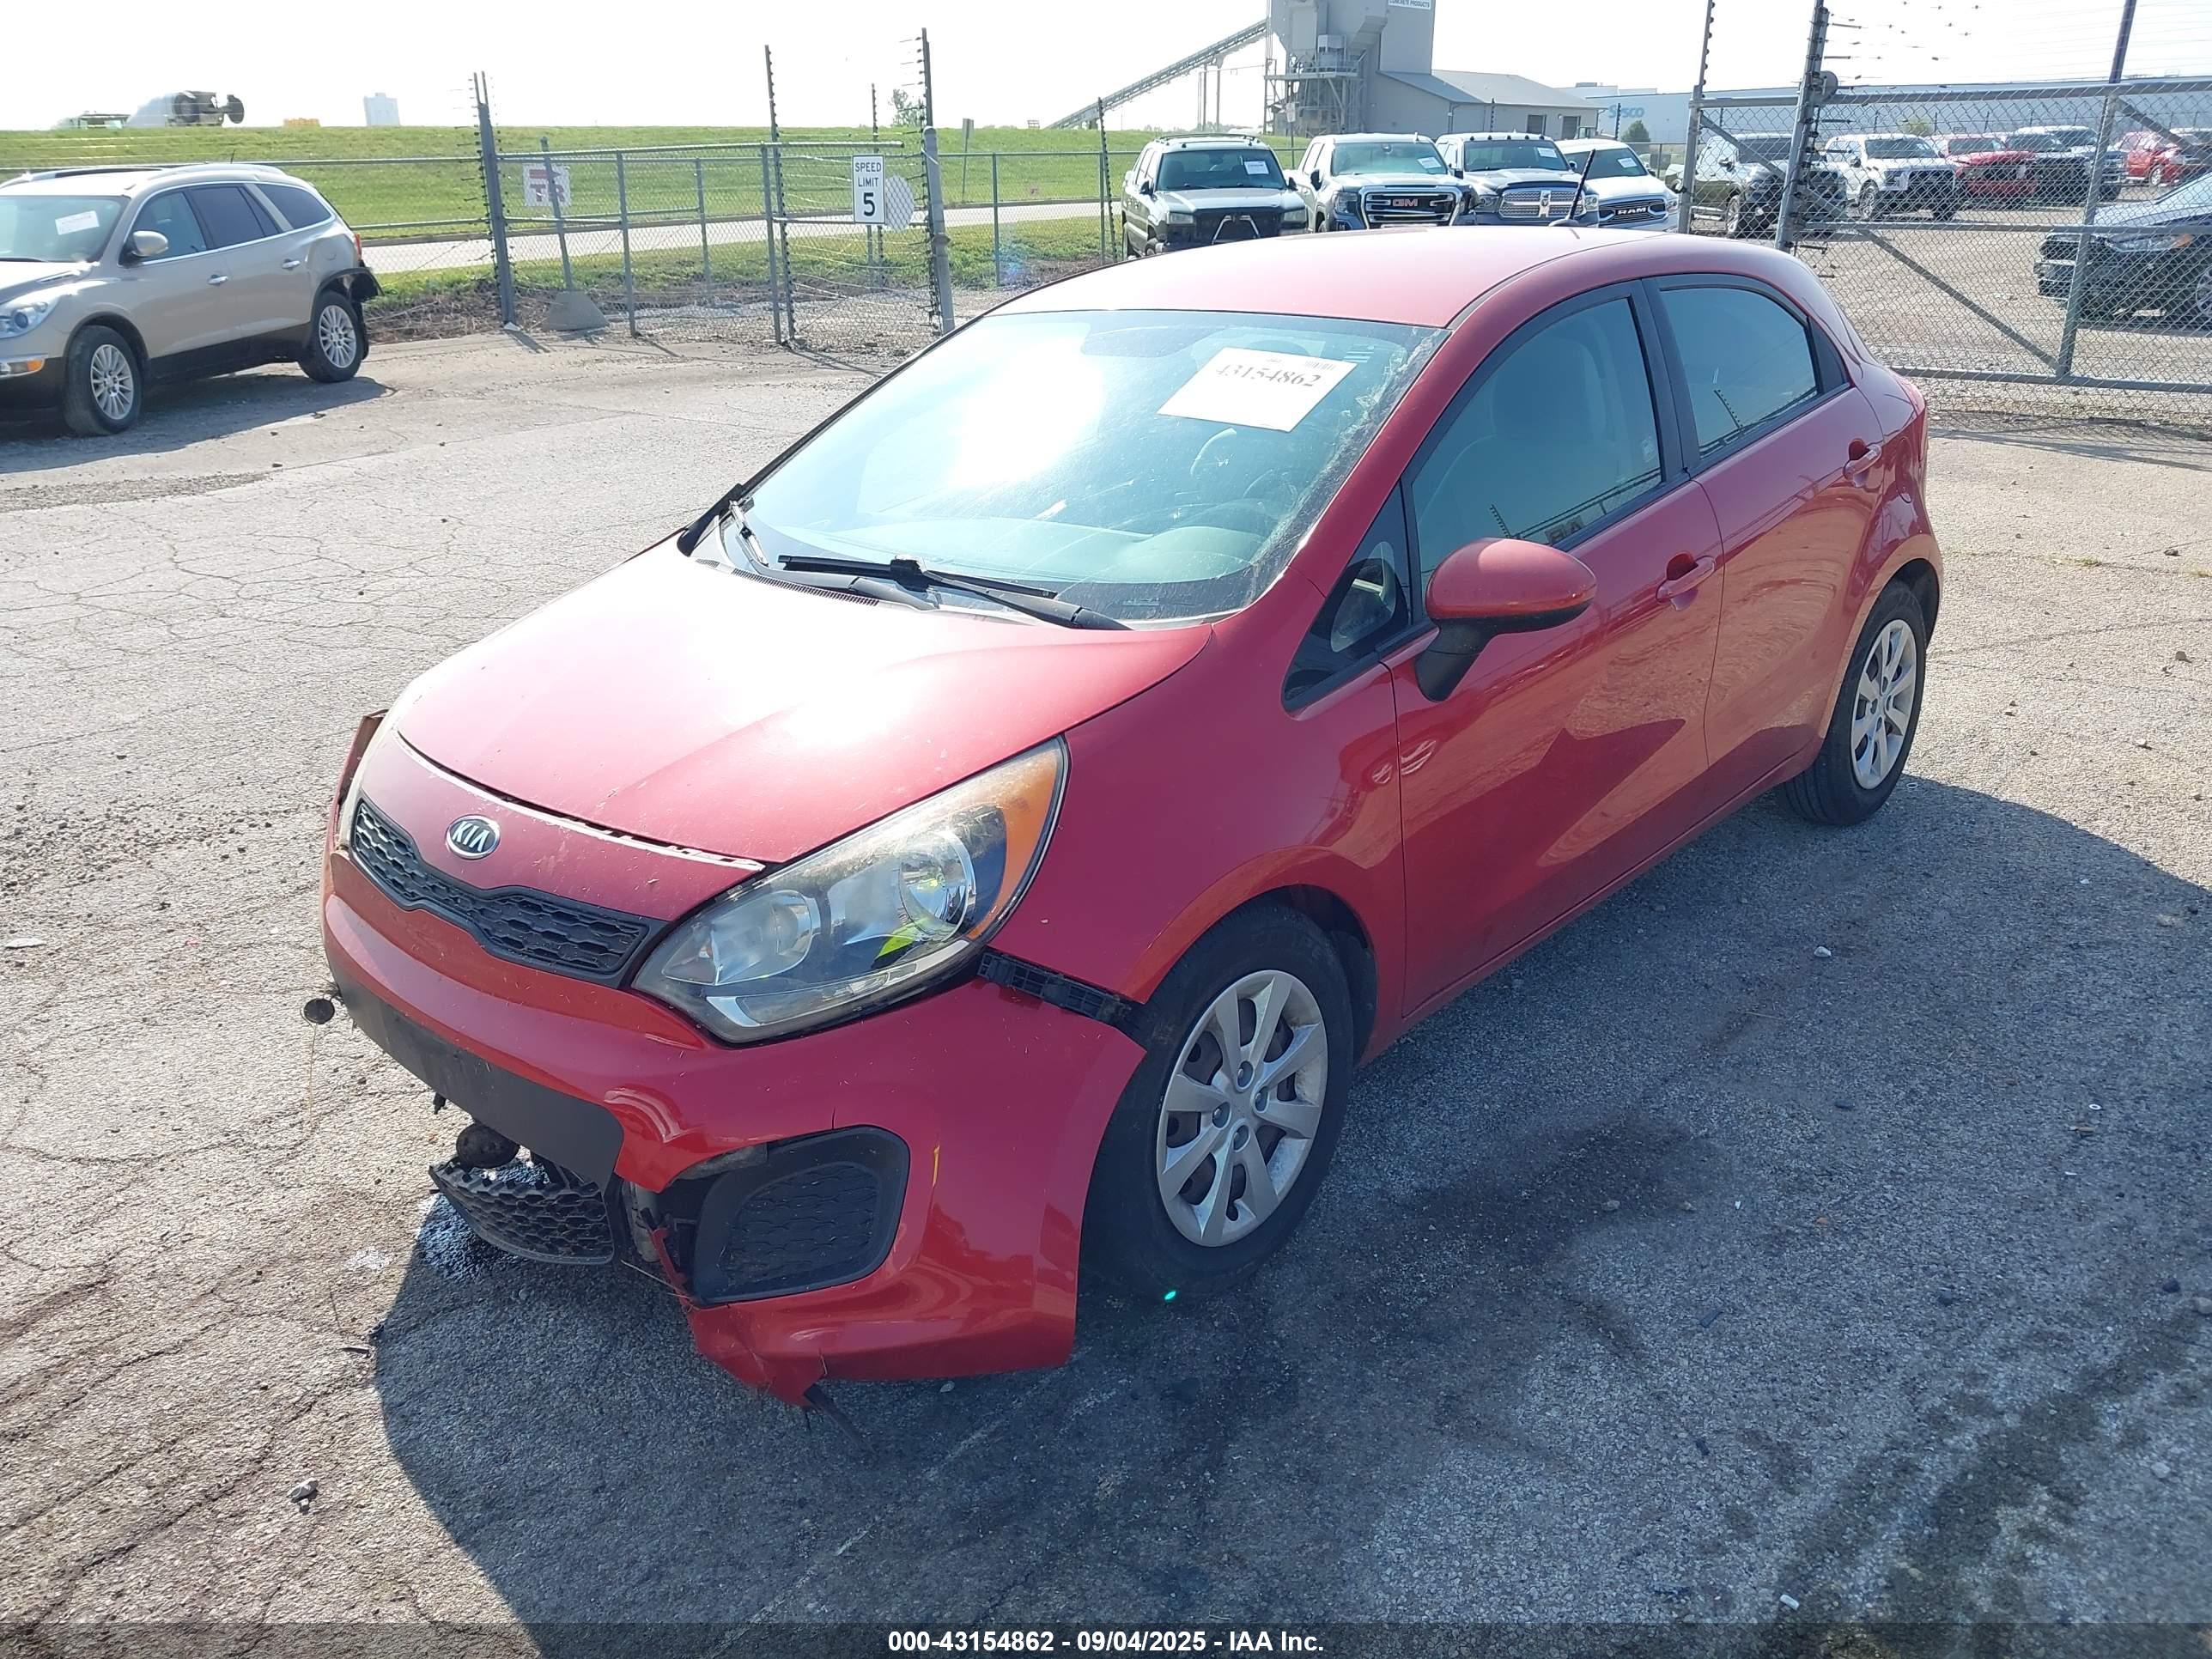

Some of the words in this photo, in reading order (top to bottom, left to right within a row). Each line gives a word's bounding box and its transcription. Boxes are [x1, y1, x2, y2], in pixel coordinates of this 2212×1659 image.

[855, 161, 882, 172] SPEED
[858, 177, 878, 186] LIMIT
[863, 191, 876, 216] 5
[452, 820, 490, 853] KIA
